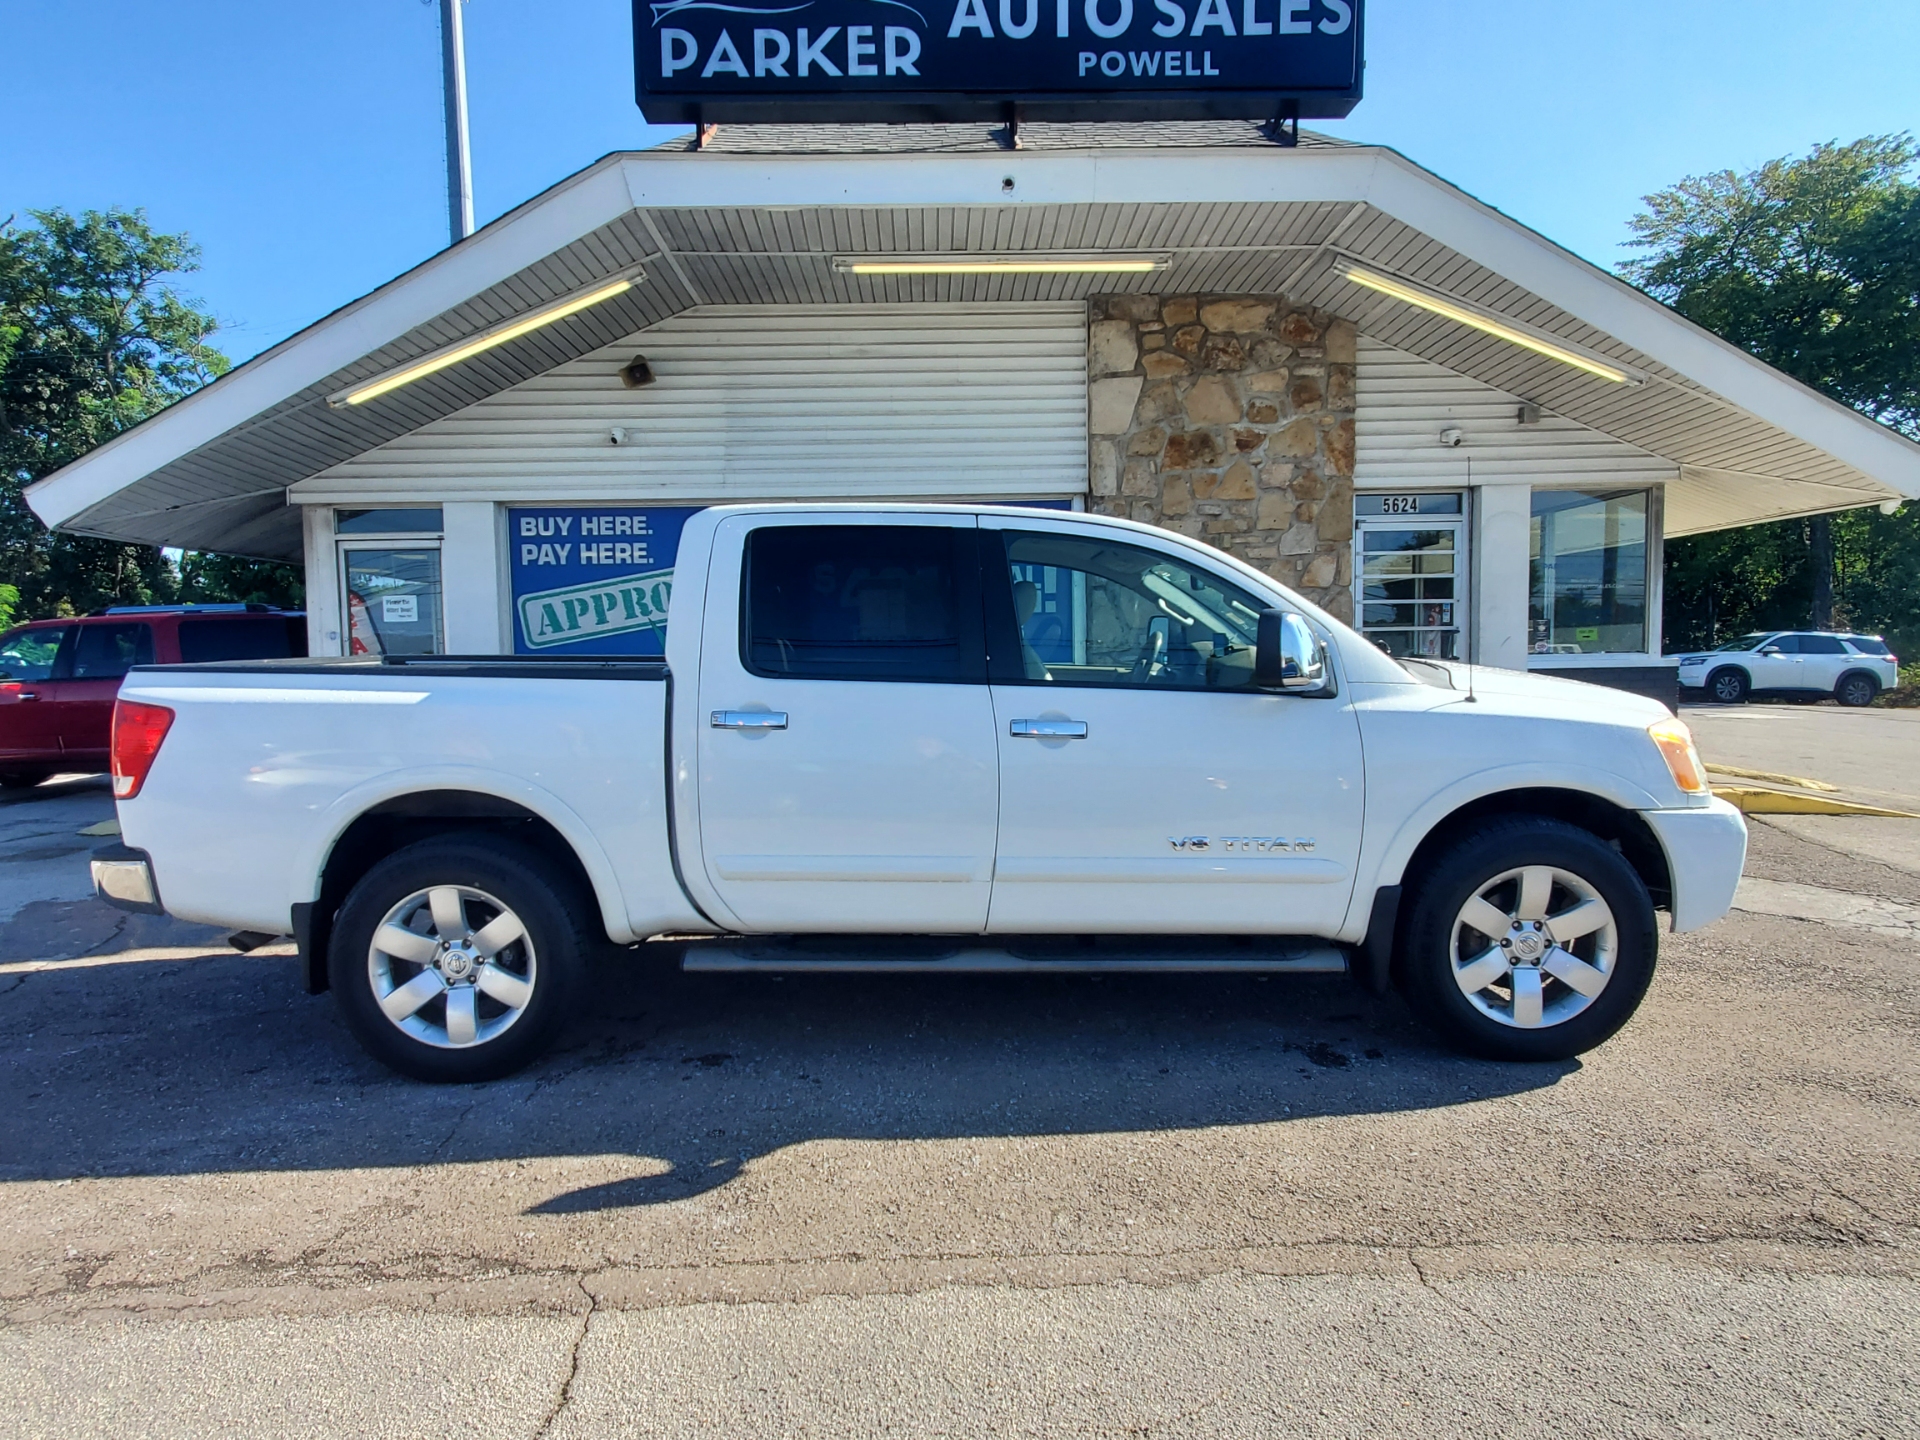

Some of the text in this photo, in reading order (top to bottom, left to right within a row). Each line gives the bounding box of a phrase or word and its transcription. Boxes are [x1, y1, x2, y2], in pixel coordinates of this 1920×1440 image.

[1151, 0, 1352, 38] SALES
[660, 25, 921, 77] PARKER
[1078, 51, 1219, 77] POWELL
[1383, 497, 1417, 512] 5624
[520, 515, 653, 536] BUY HERE.
[521, 542, 654, 565] PAY HERE.
[1167, 836, 1316, 852] V8 TITAN
